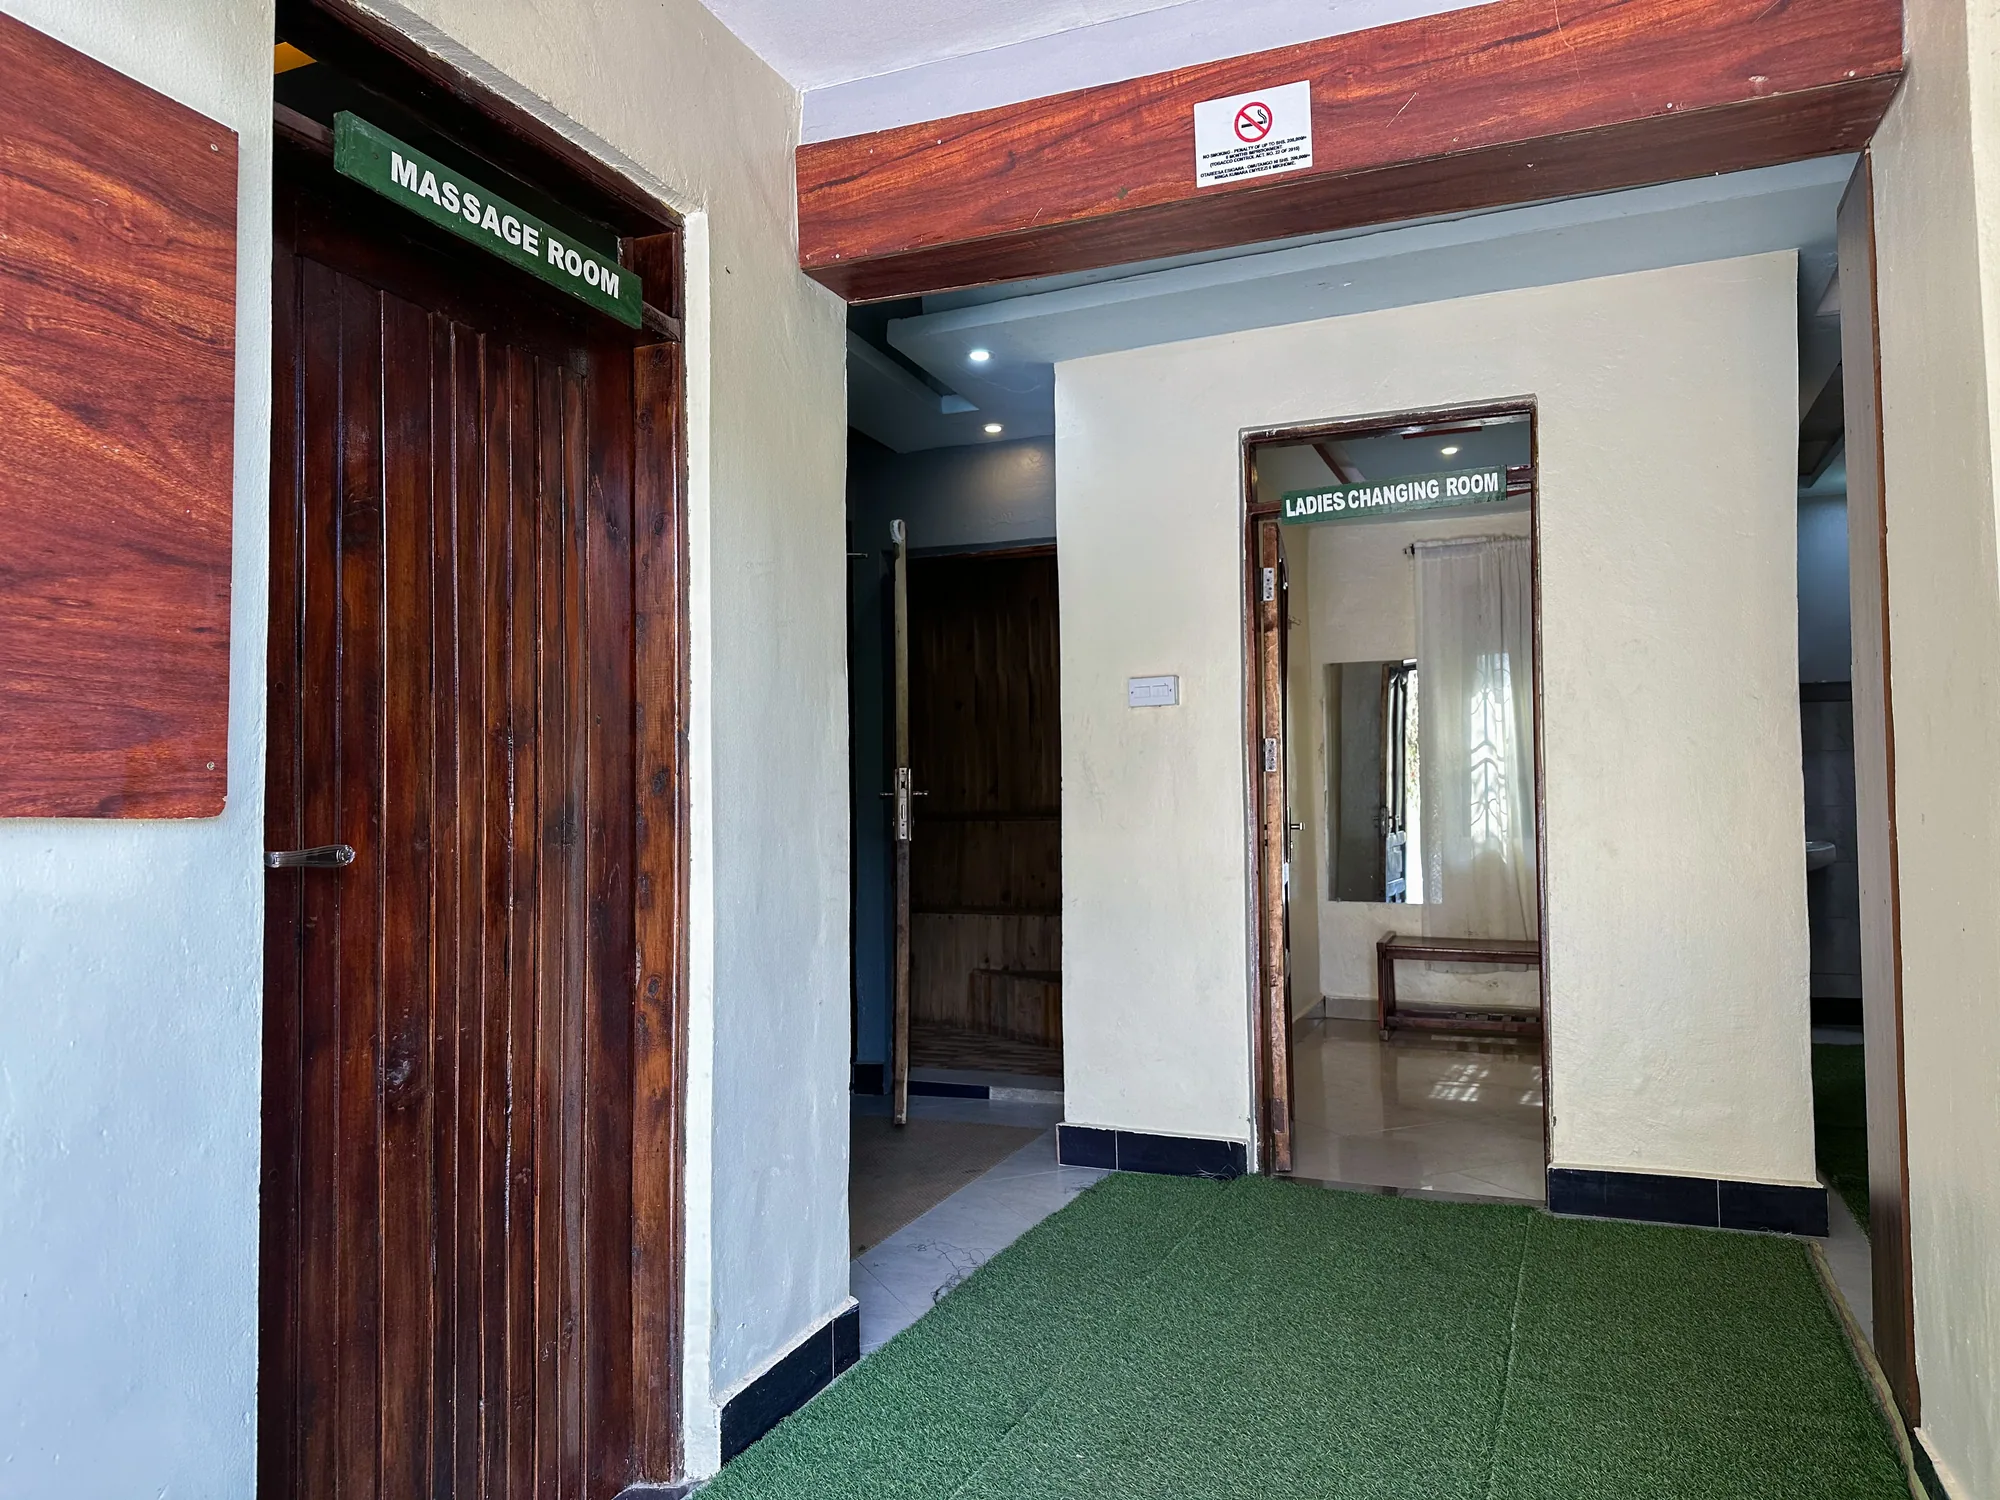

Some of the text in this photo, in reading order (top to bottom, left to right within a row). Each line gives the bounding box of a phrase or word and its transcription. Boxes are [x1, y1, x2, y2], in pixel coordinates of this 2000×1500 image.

[391, 151, 620, 299] MASSAGE ROOM
[1285, 472, 1499, 518] LADIES CHANGING ROOM
